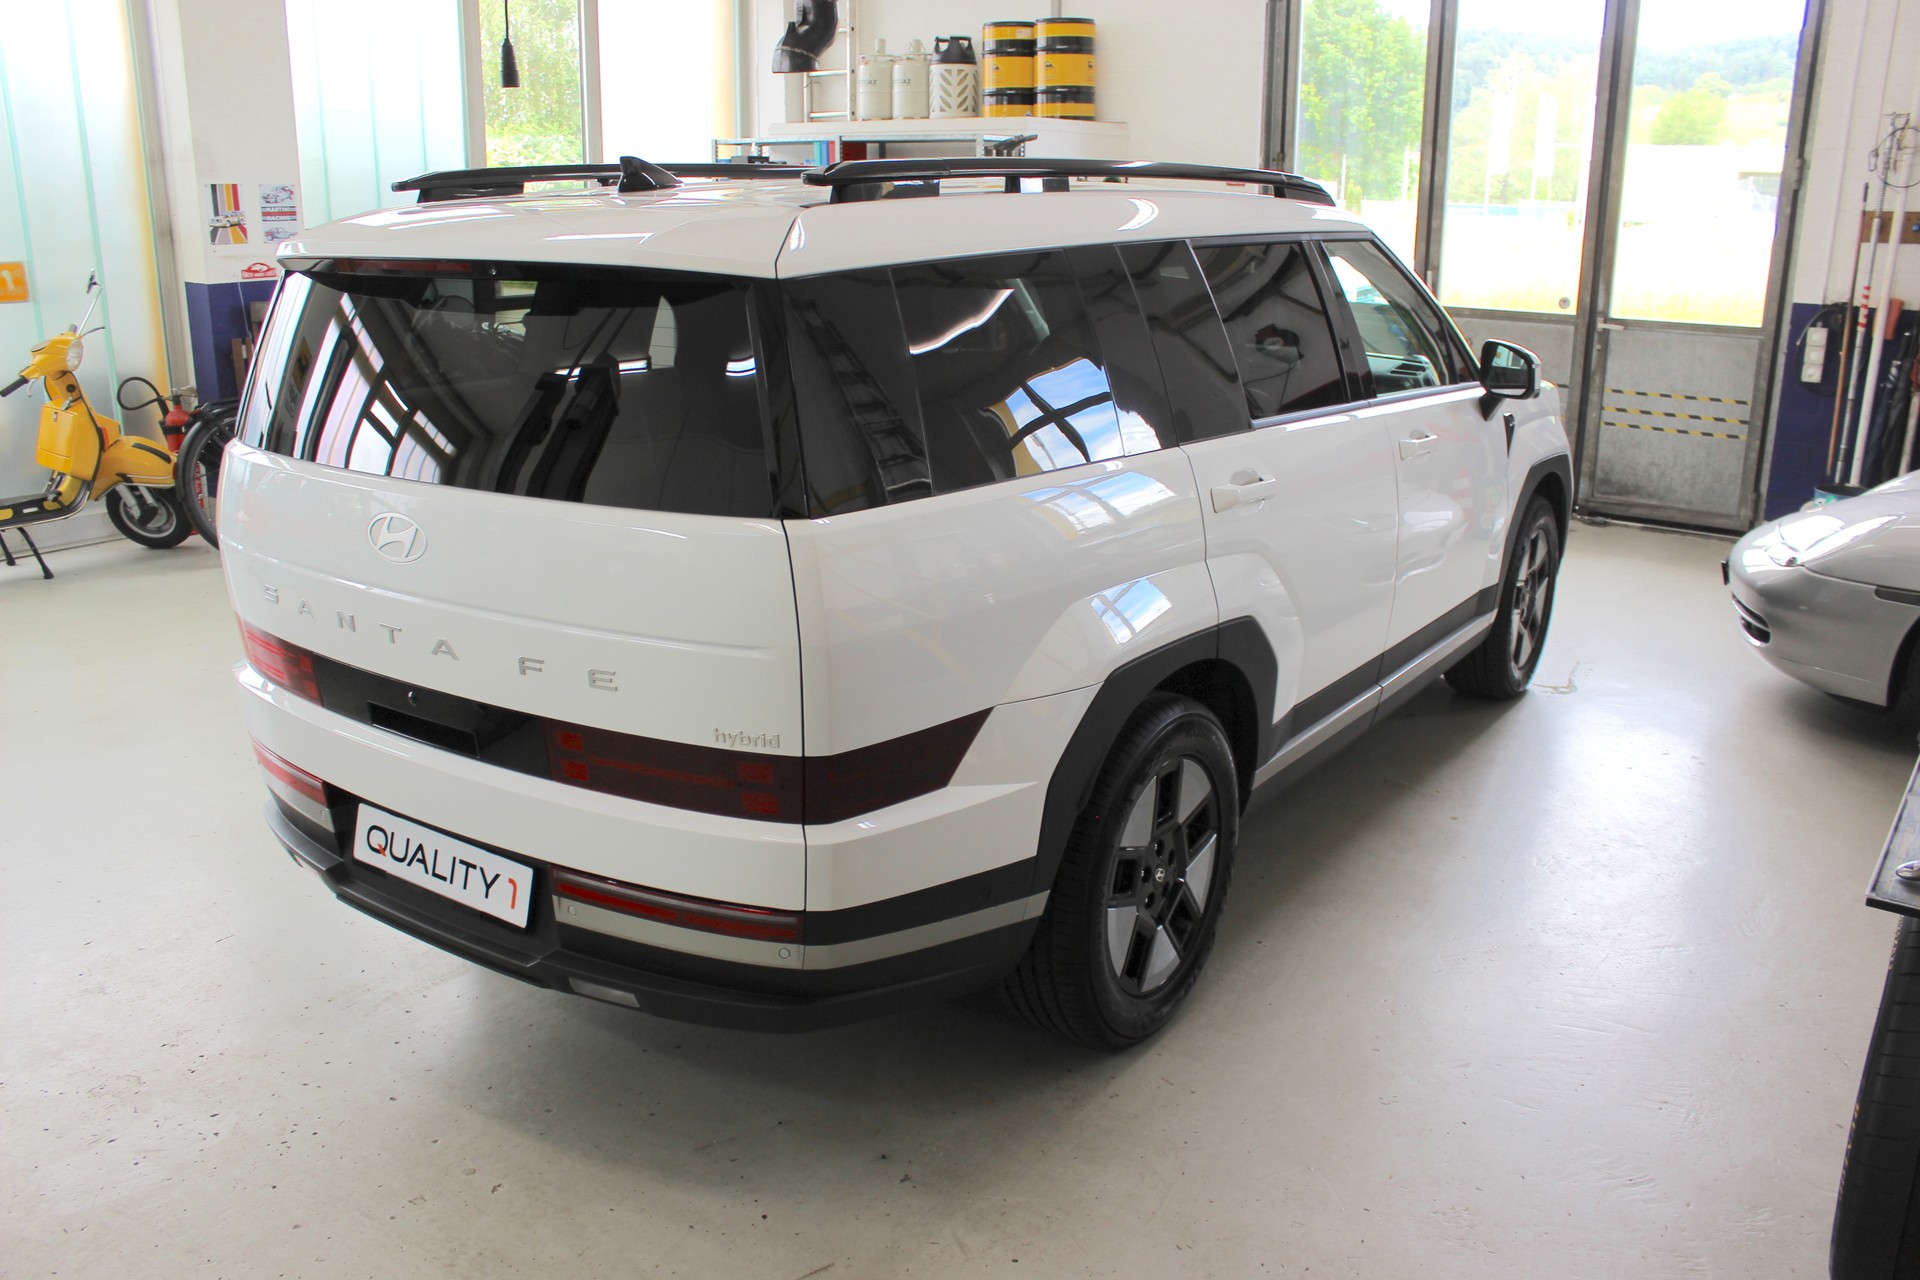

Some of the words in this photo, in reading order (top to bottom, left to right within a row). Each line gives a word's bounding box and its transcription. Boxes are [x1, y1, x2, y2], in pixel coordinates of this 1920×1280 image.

[264, 584, 460, 661] SANTA
[518, 655, 618, 692] FE
[714, 727, 781, 749] hybrid
